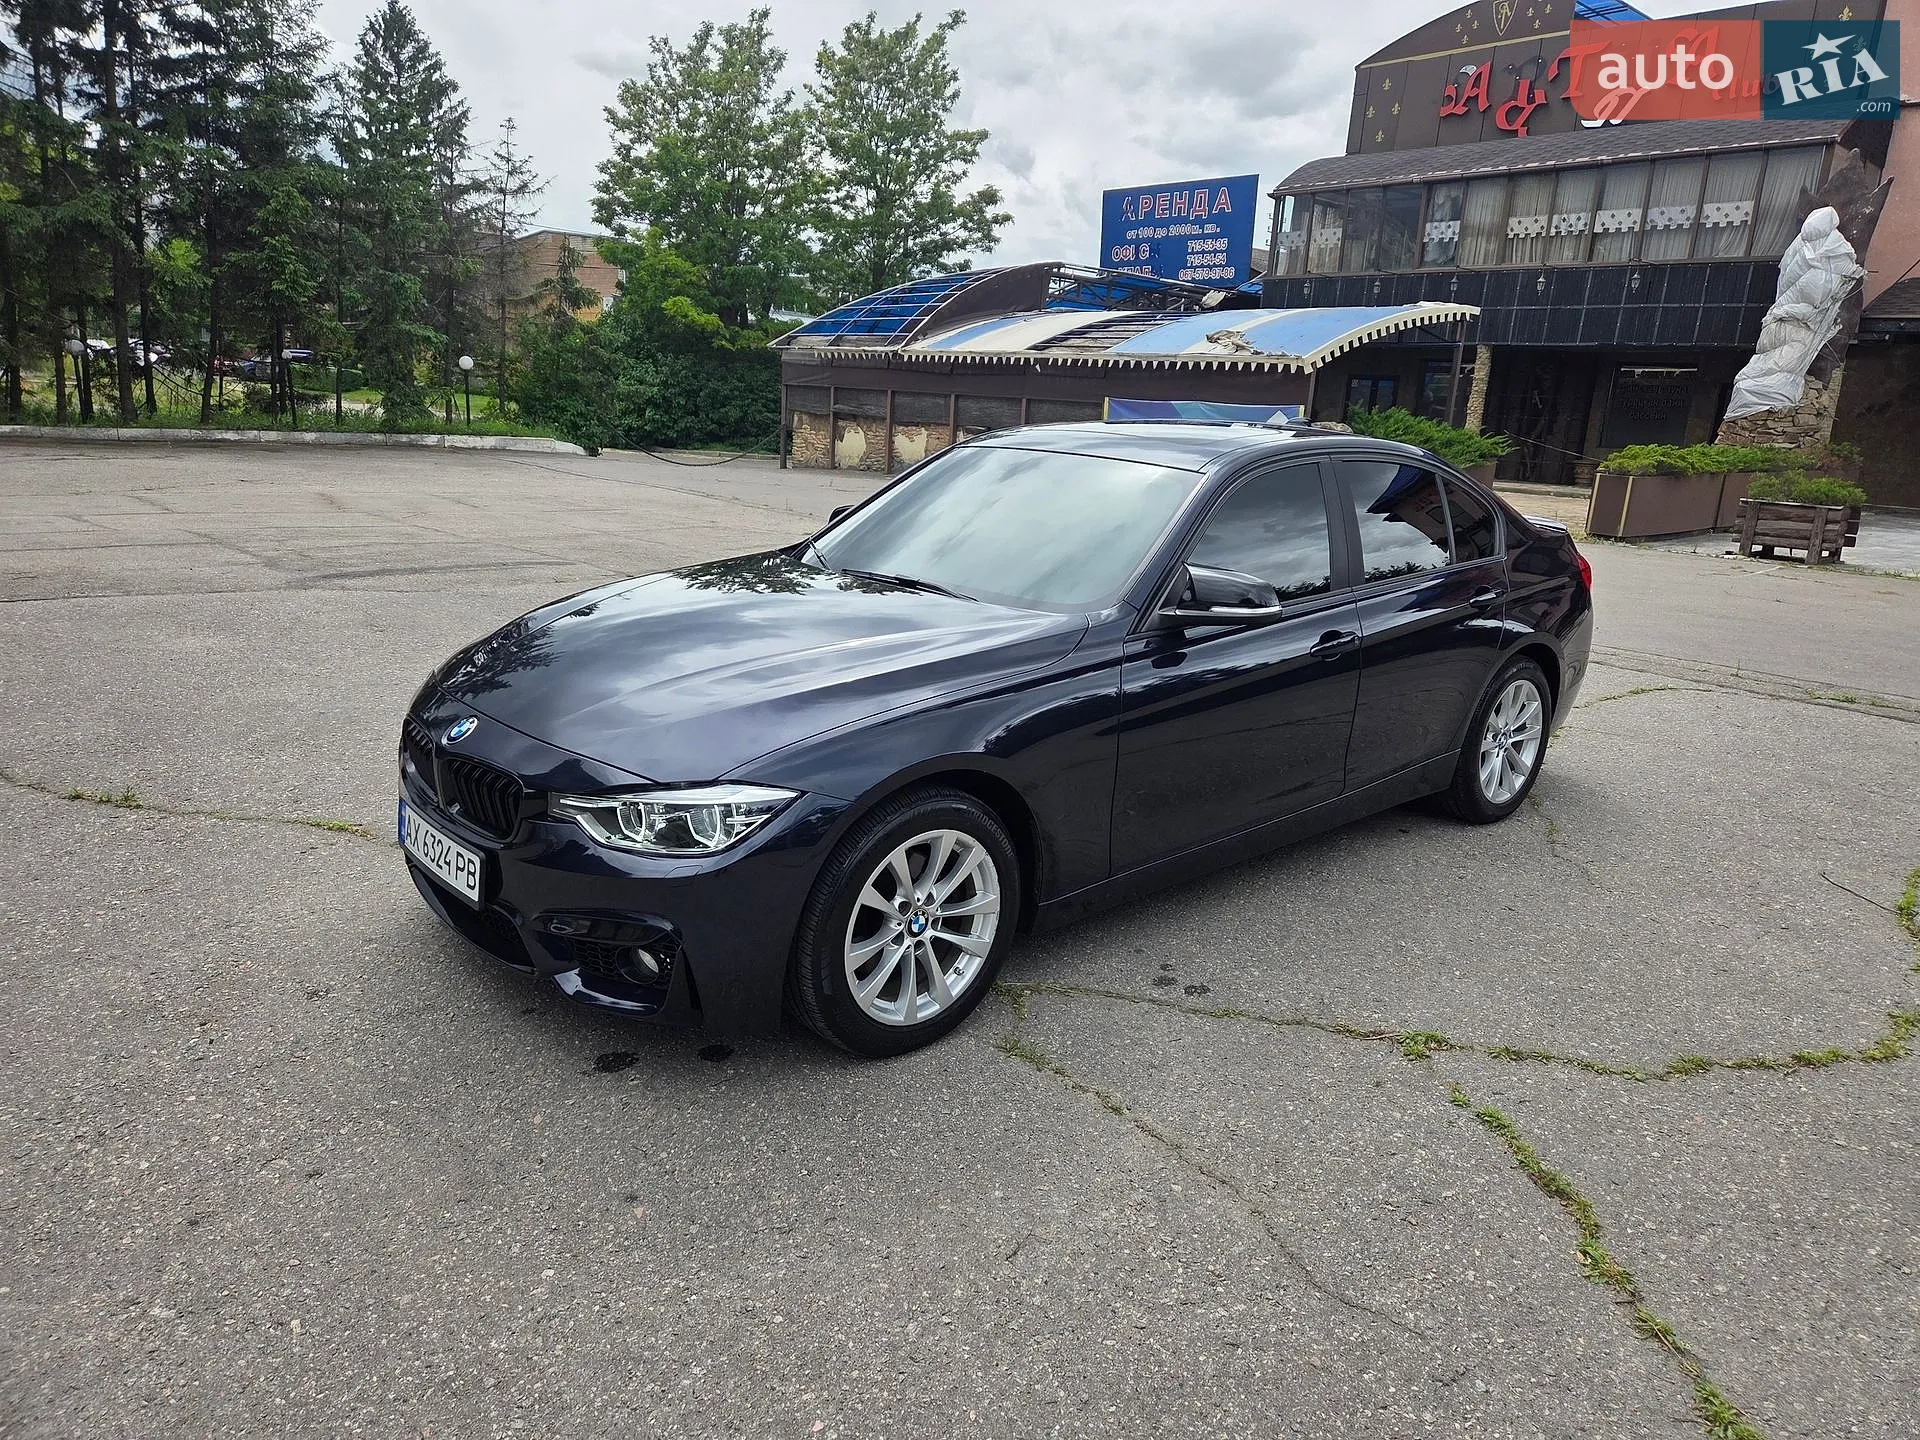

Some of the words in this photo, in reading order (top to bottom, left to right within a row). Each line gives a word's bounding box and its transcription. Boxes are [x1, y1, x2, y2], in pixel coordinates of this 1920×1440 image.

[1138, 226, 1154, 238] 100
[423, 829, 452, 876] 6324
[455, 850, 477, 891] PB
